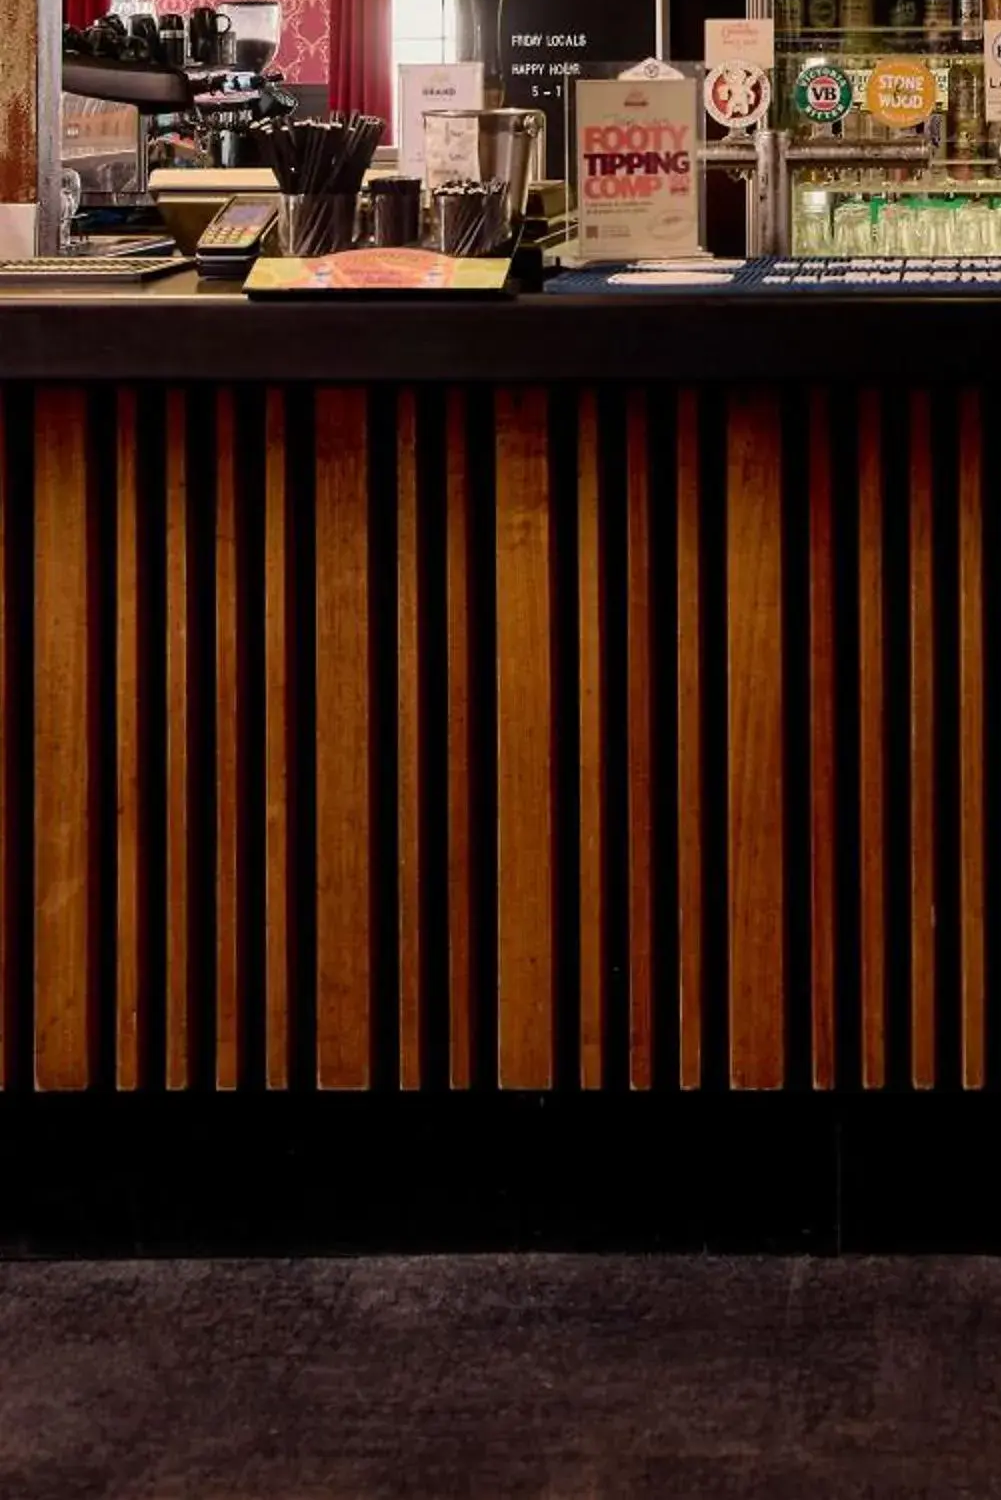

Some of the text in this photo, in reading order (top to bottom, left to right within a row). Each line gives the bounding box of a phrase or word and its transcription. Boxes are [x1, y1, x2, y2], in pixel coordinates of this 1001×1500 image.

[511, 34, 587, 47] FRIDAY LOCALS
[511, 63, 545, 76] HAPPY
[878, 74, 924, 91] STONE
[810, 85, 838, 104] VB
[878, 91, 923, 110] WOOD
[583, 126, 689, 152] FOOTY
[583, 151, 690, 176] TIPPING
[583, 177, 662, 200] COMP
